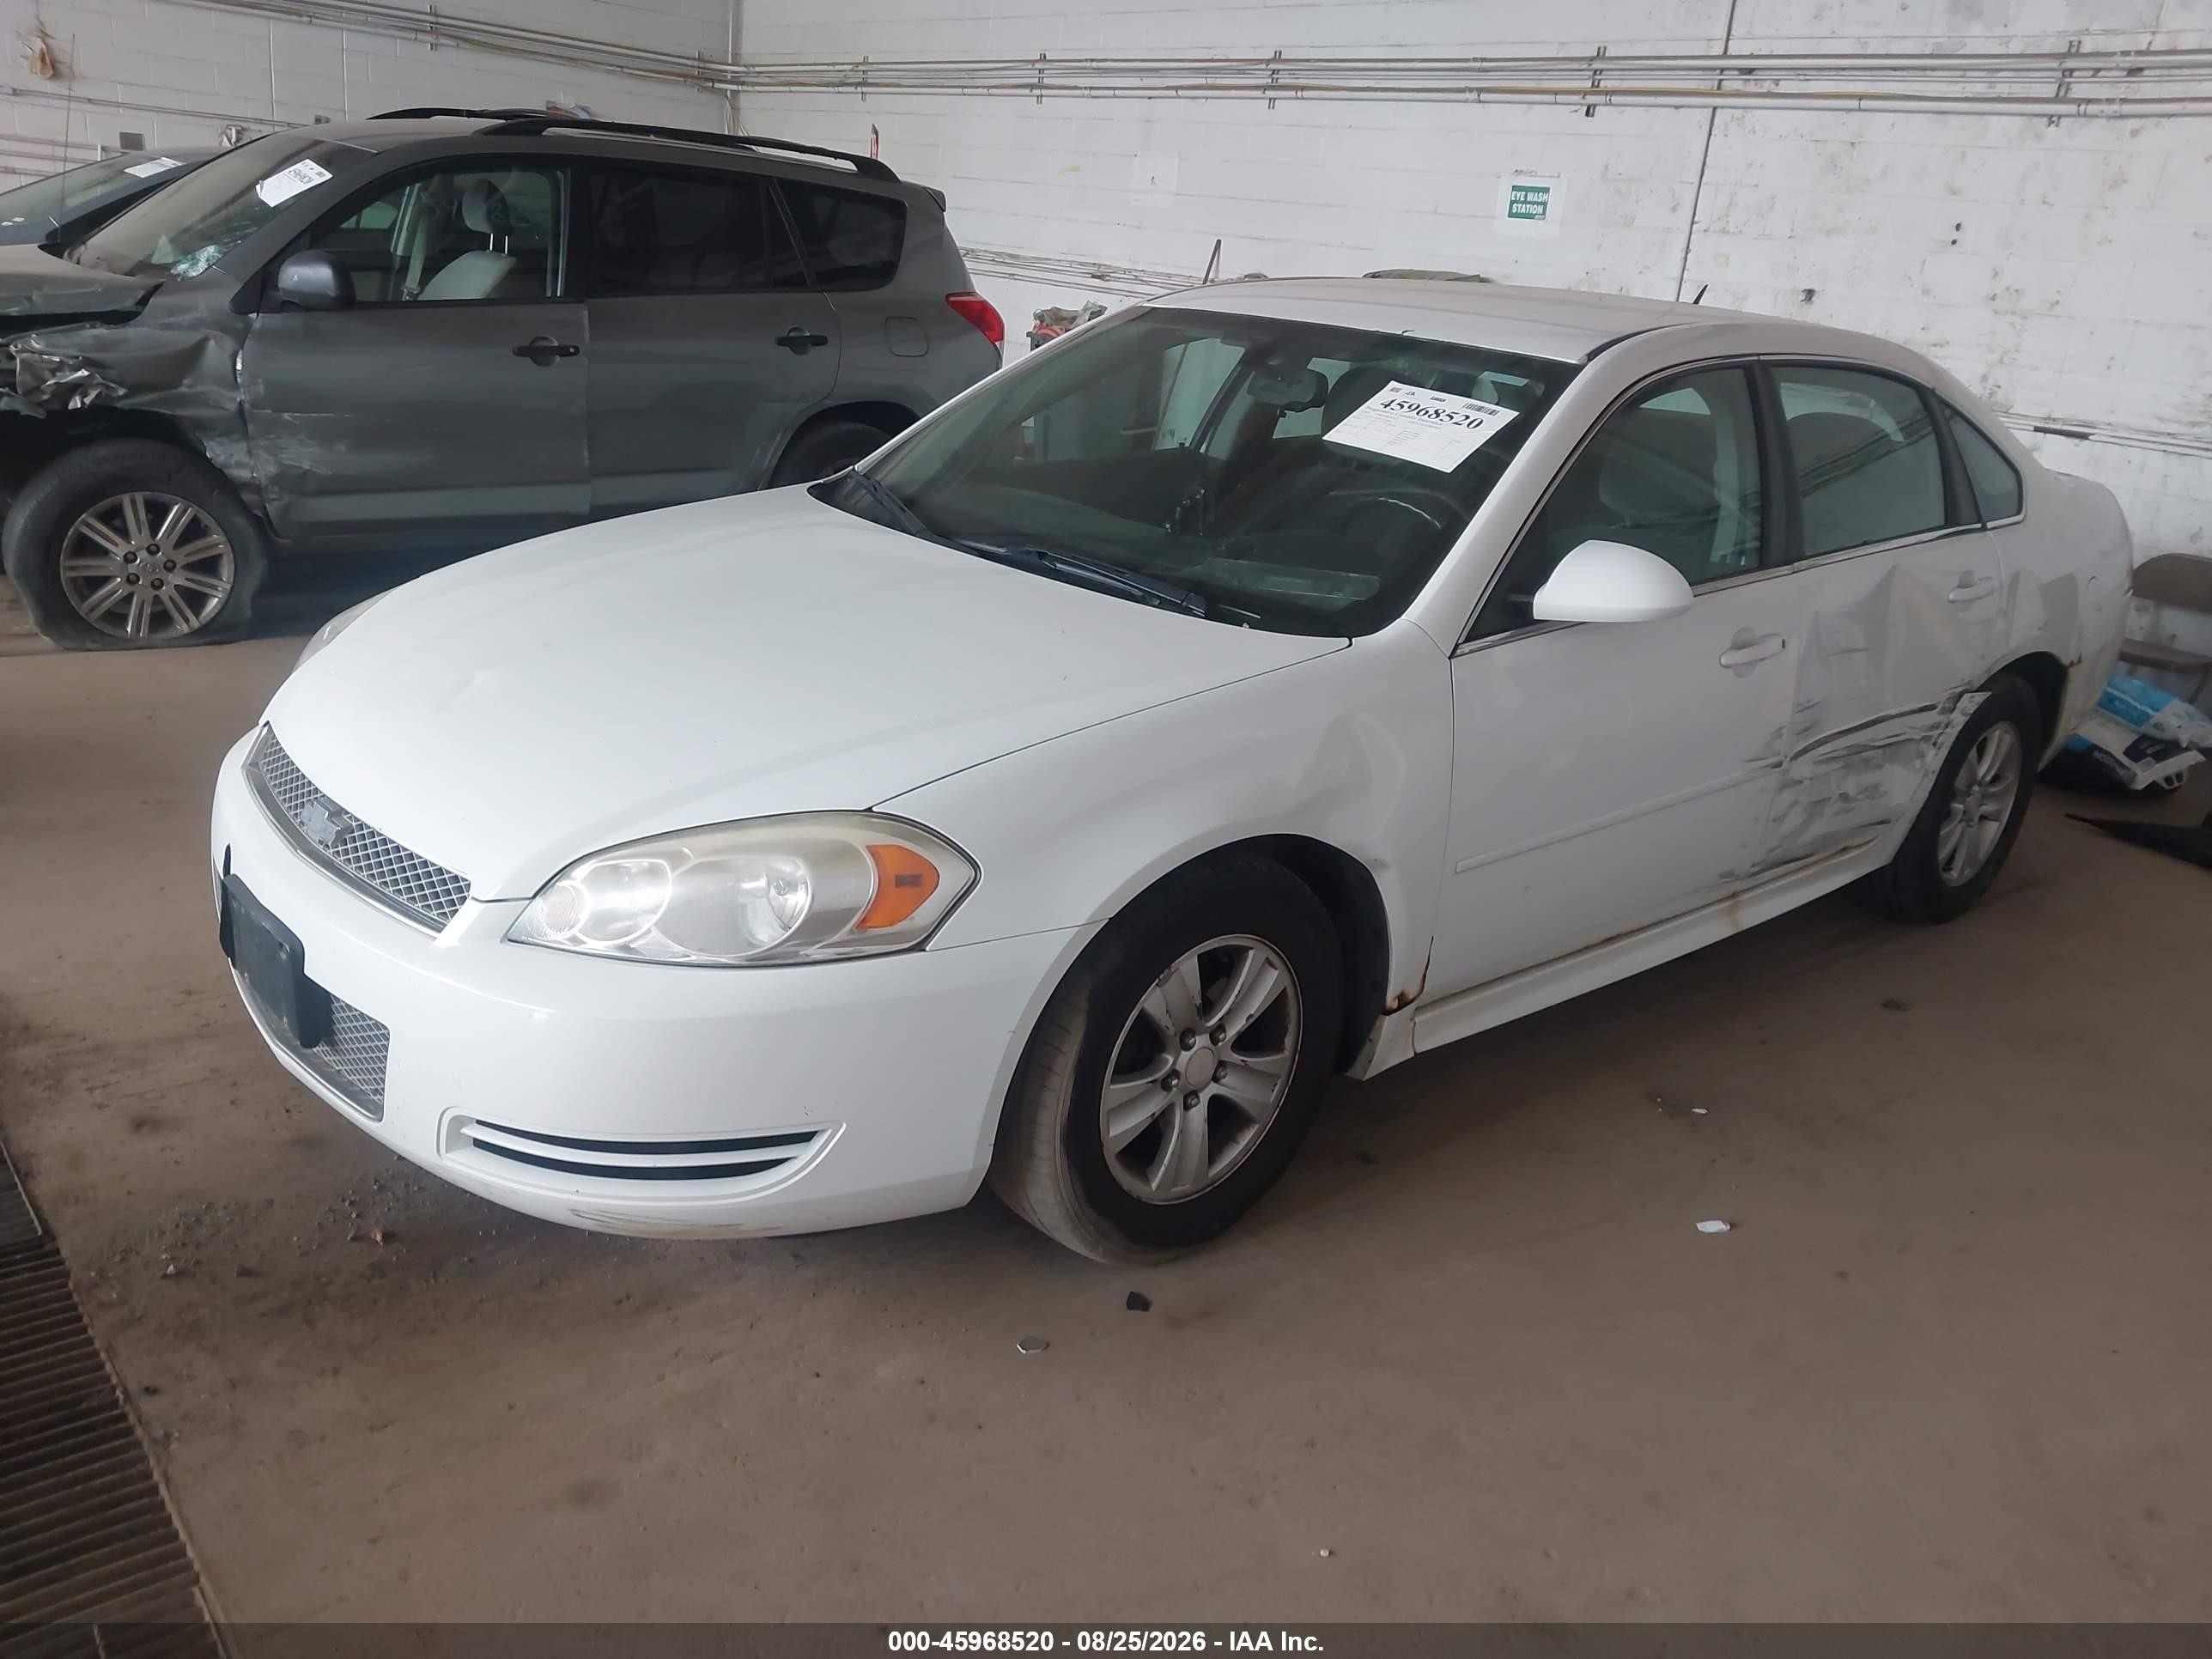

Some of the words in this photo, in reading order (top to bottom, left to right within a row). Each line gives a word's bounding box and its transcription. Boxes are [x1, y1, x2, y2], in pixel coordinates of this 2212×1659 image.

[1511, 191, 1526, 201] EYE
[1527, 191, 1549, 203] WASH
[1512, 203, 1544, 214] STATION
[1380, 398, 1485, 430] 45968520
